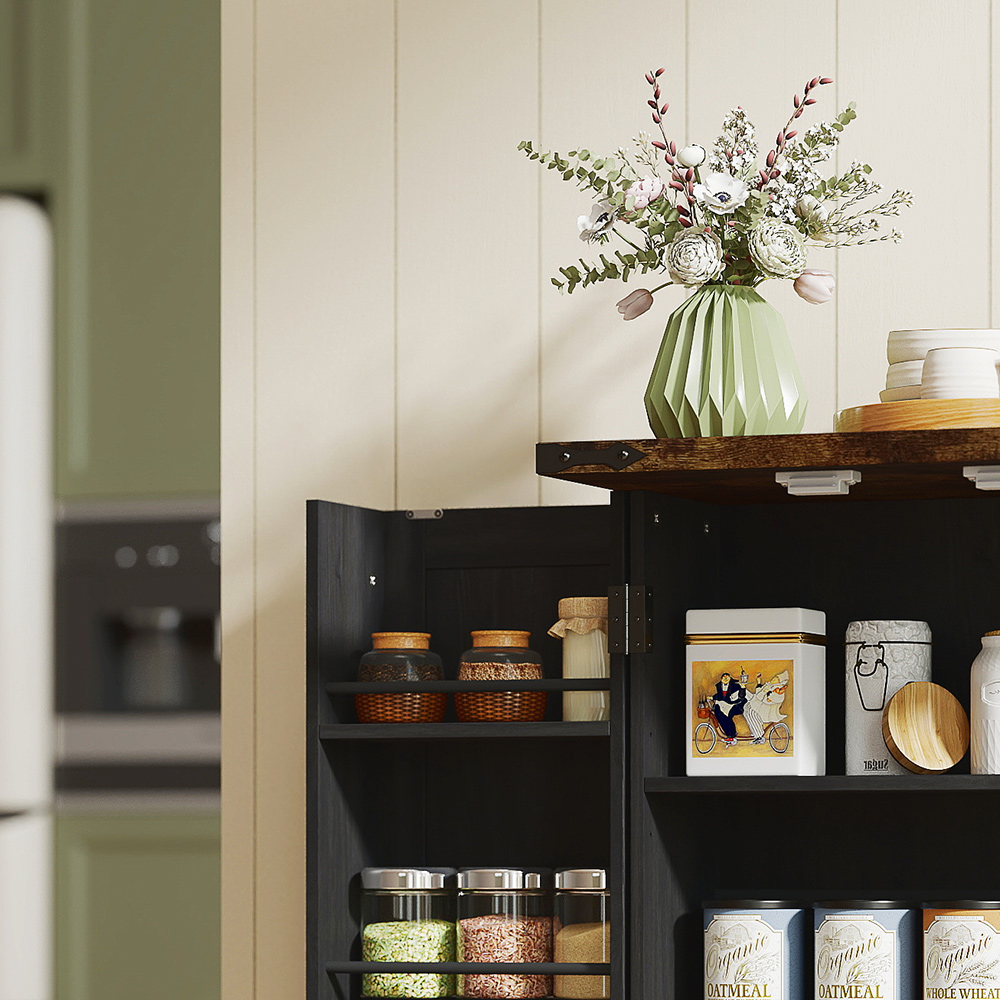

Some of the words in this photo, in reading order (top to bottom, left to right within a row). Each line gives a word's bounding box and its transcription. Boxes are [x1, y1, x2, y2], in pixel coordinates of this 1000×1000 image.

[706, 932, 769, 979] Organic
[817, 933, 881, 983] Organic
[927, 933, 993, 983] Organic
[707, 983, 771, 998] OATMEAL
[818, 984, 884, 999] OATMEAL
[926, 987, 957, 999] WHOLE
[959, 988, 1000, 1000] WHEAT
